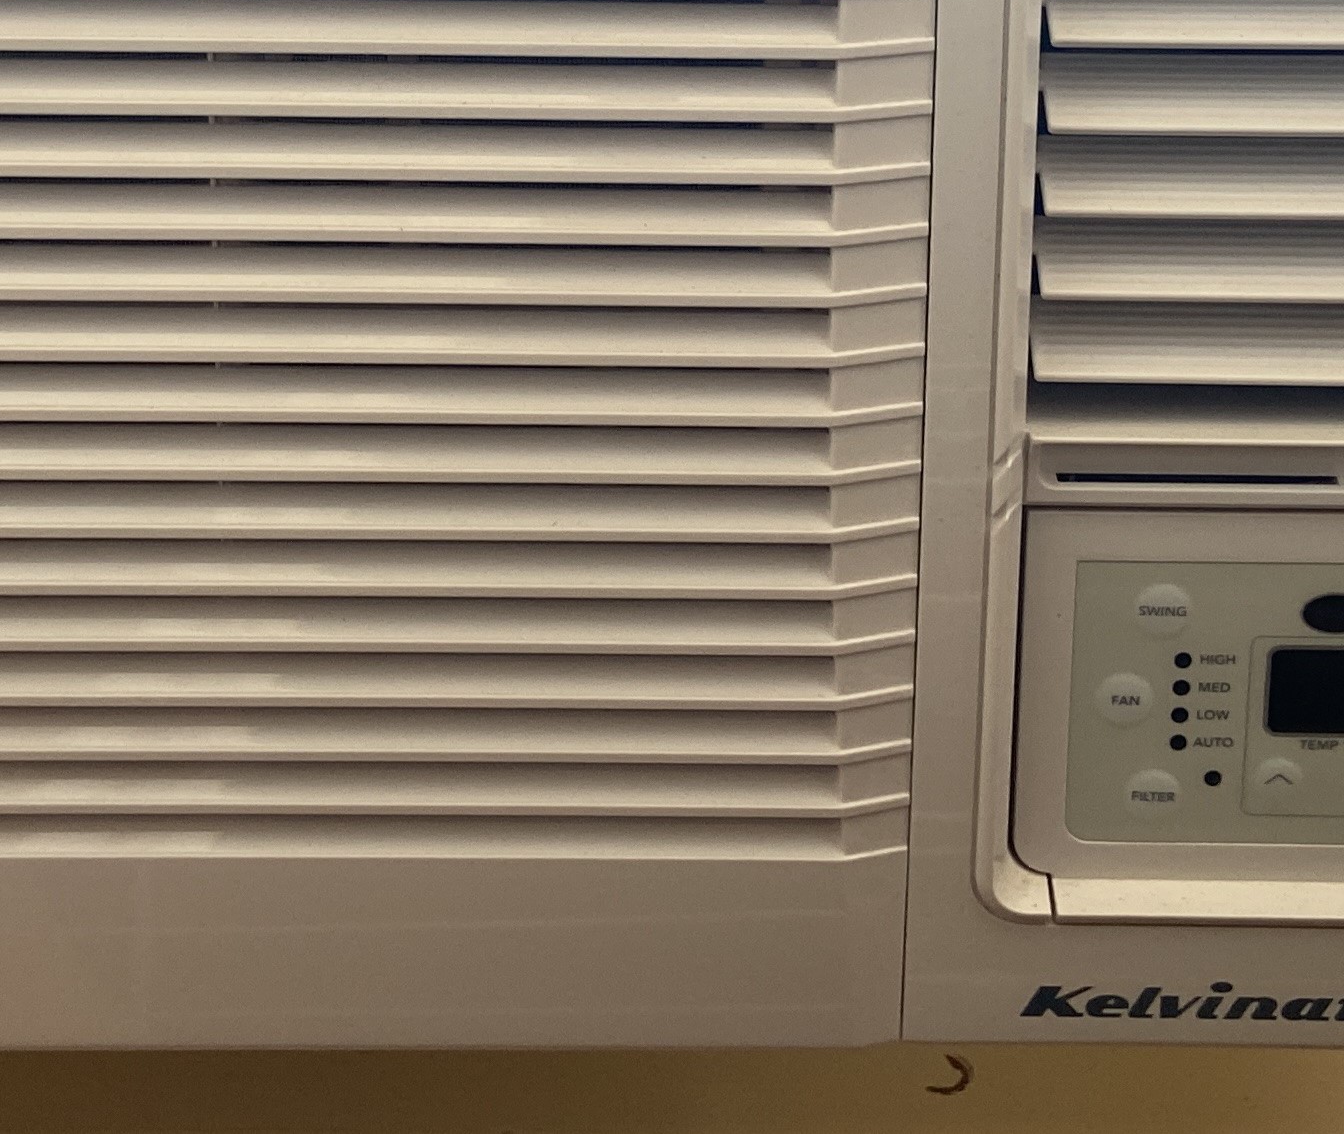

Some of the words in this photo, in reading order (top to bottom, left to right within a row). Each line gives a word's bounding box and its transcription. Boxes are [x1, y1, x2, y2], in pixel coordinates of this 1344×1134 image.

[1138, 605, 1187, 617] SWING
[1199, 653, 1236, 665] HIGH
[1198, 682, 1231, 693] MED
[1111, 695, 1141, 706] FAN
[1196, 709, 1230, 720] LOW
[1193, 737, 1234, 748] AUTO
[1301, 739, 1339, 751] TEMP
[1131, 790, 1175, 802] FILTER
